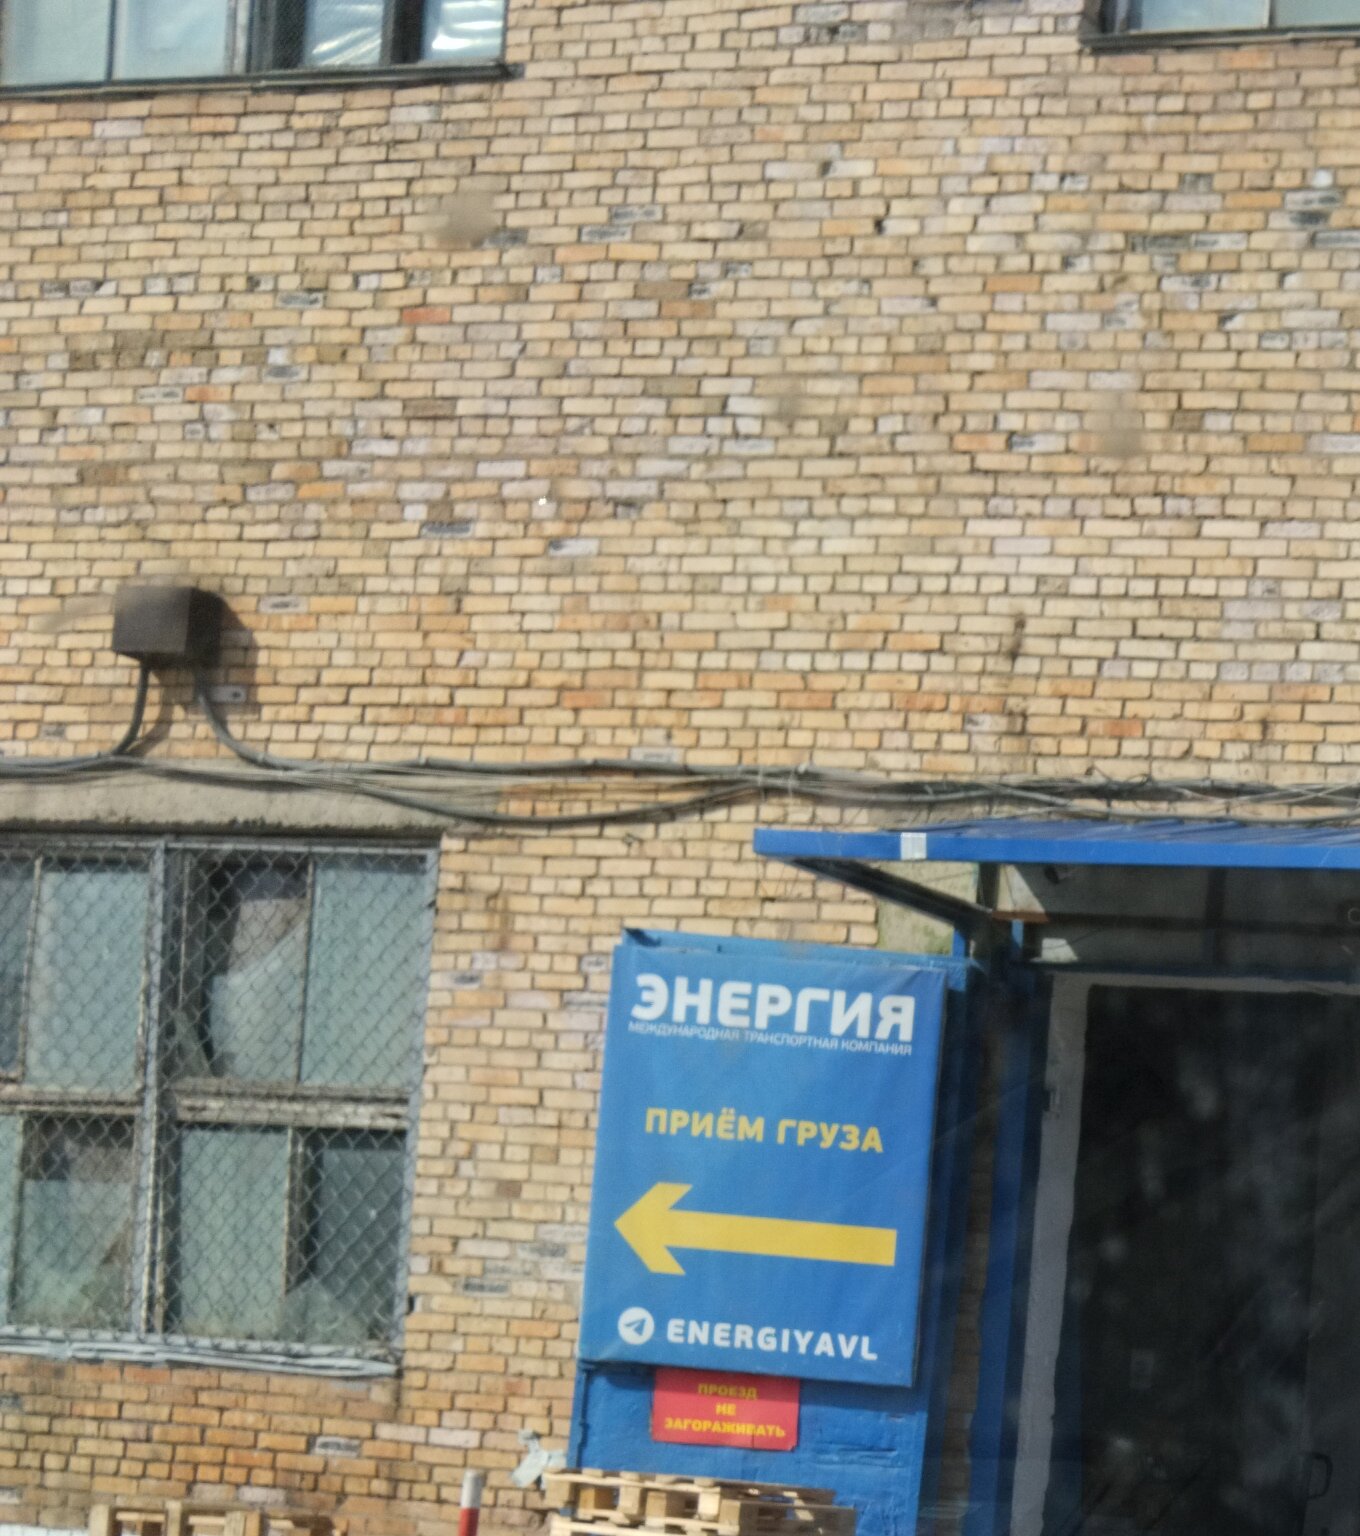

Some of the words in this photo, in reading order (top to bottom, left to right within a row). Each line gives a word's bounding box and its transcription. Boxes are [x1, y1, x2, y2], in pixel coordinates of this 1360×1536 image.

[631, 974, 915, 1041] ЭНЕРГИЯ
[628, 1020, 740, 1041] МЕЖДУНАРОДНАЯ
[744, 1030, 838, 1050] ТРАНСПОРТНАЯ
[841, 1040, 912, 1056] КОМПАНИЯ
[645, 1107, 765, 1143] ПРИЁМ
[776, 1118, 883, 1153] ГРУЗА
[667, 1318, 878, 1361] ENERGIYAVL
[698, 1383, 757, 1400] ПРОЕЗД
[716, 1402, 736, 1416] НЕ
[664, 1417, 786, 1438] ЗАГОРАЖИВАТЬ
